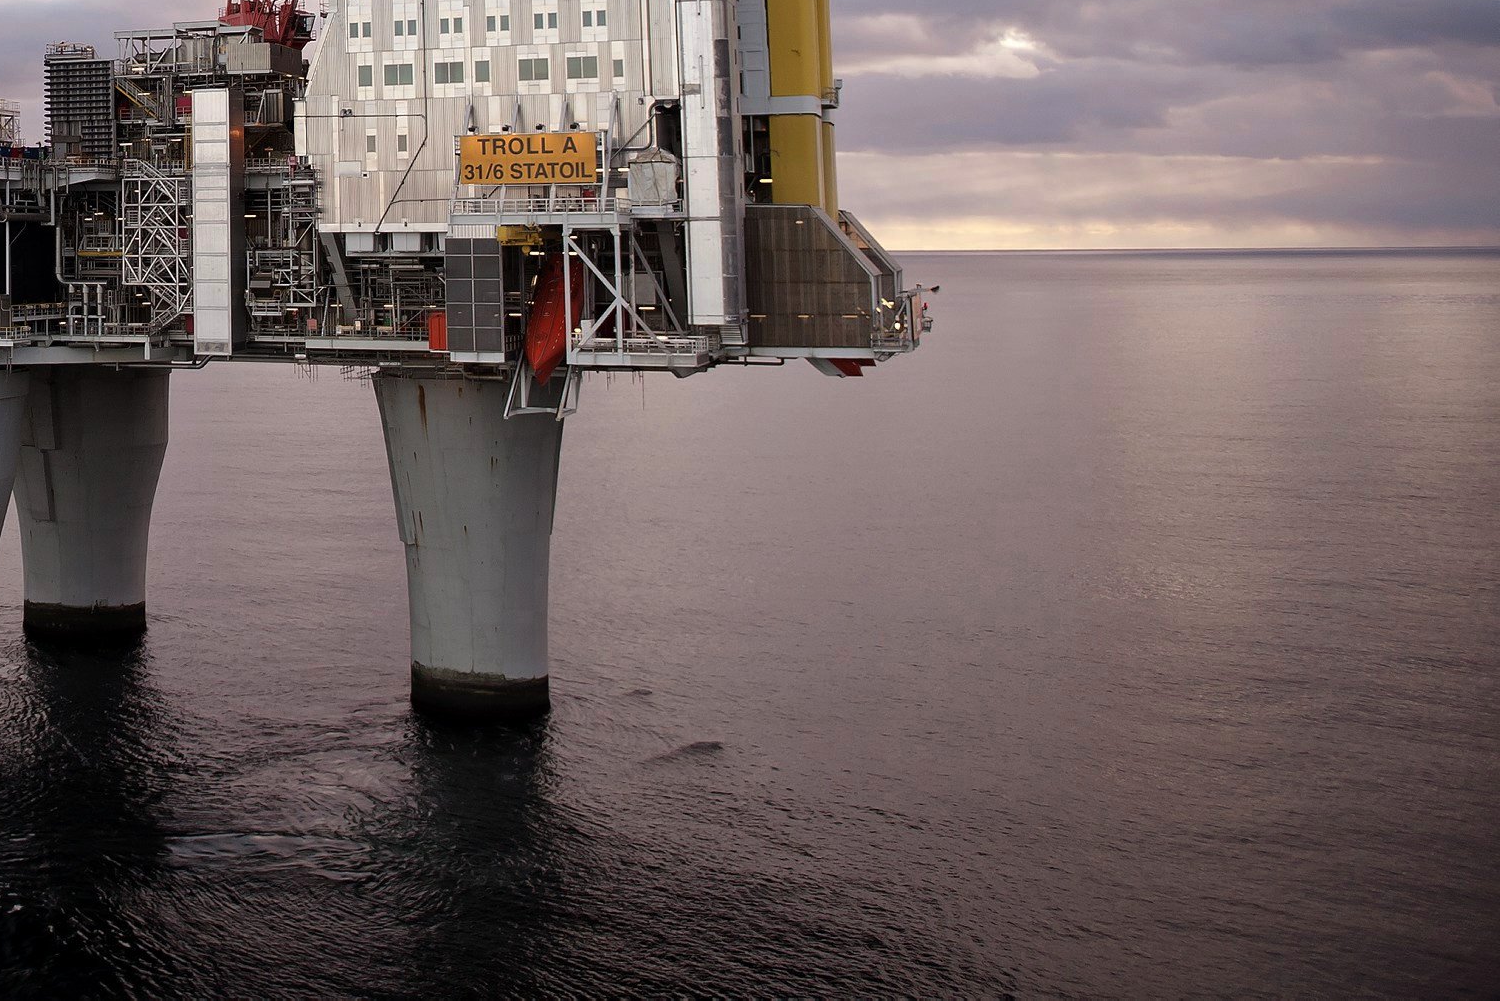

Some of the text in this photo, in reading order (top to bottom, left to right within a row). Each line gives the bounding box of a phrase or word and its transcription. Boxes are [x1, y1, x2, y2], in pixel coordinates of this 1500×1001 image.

[477, 136, 578, 155] TROLL A
[465, 161, 593, 180] 31/6 STATOIL
